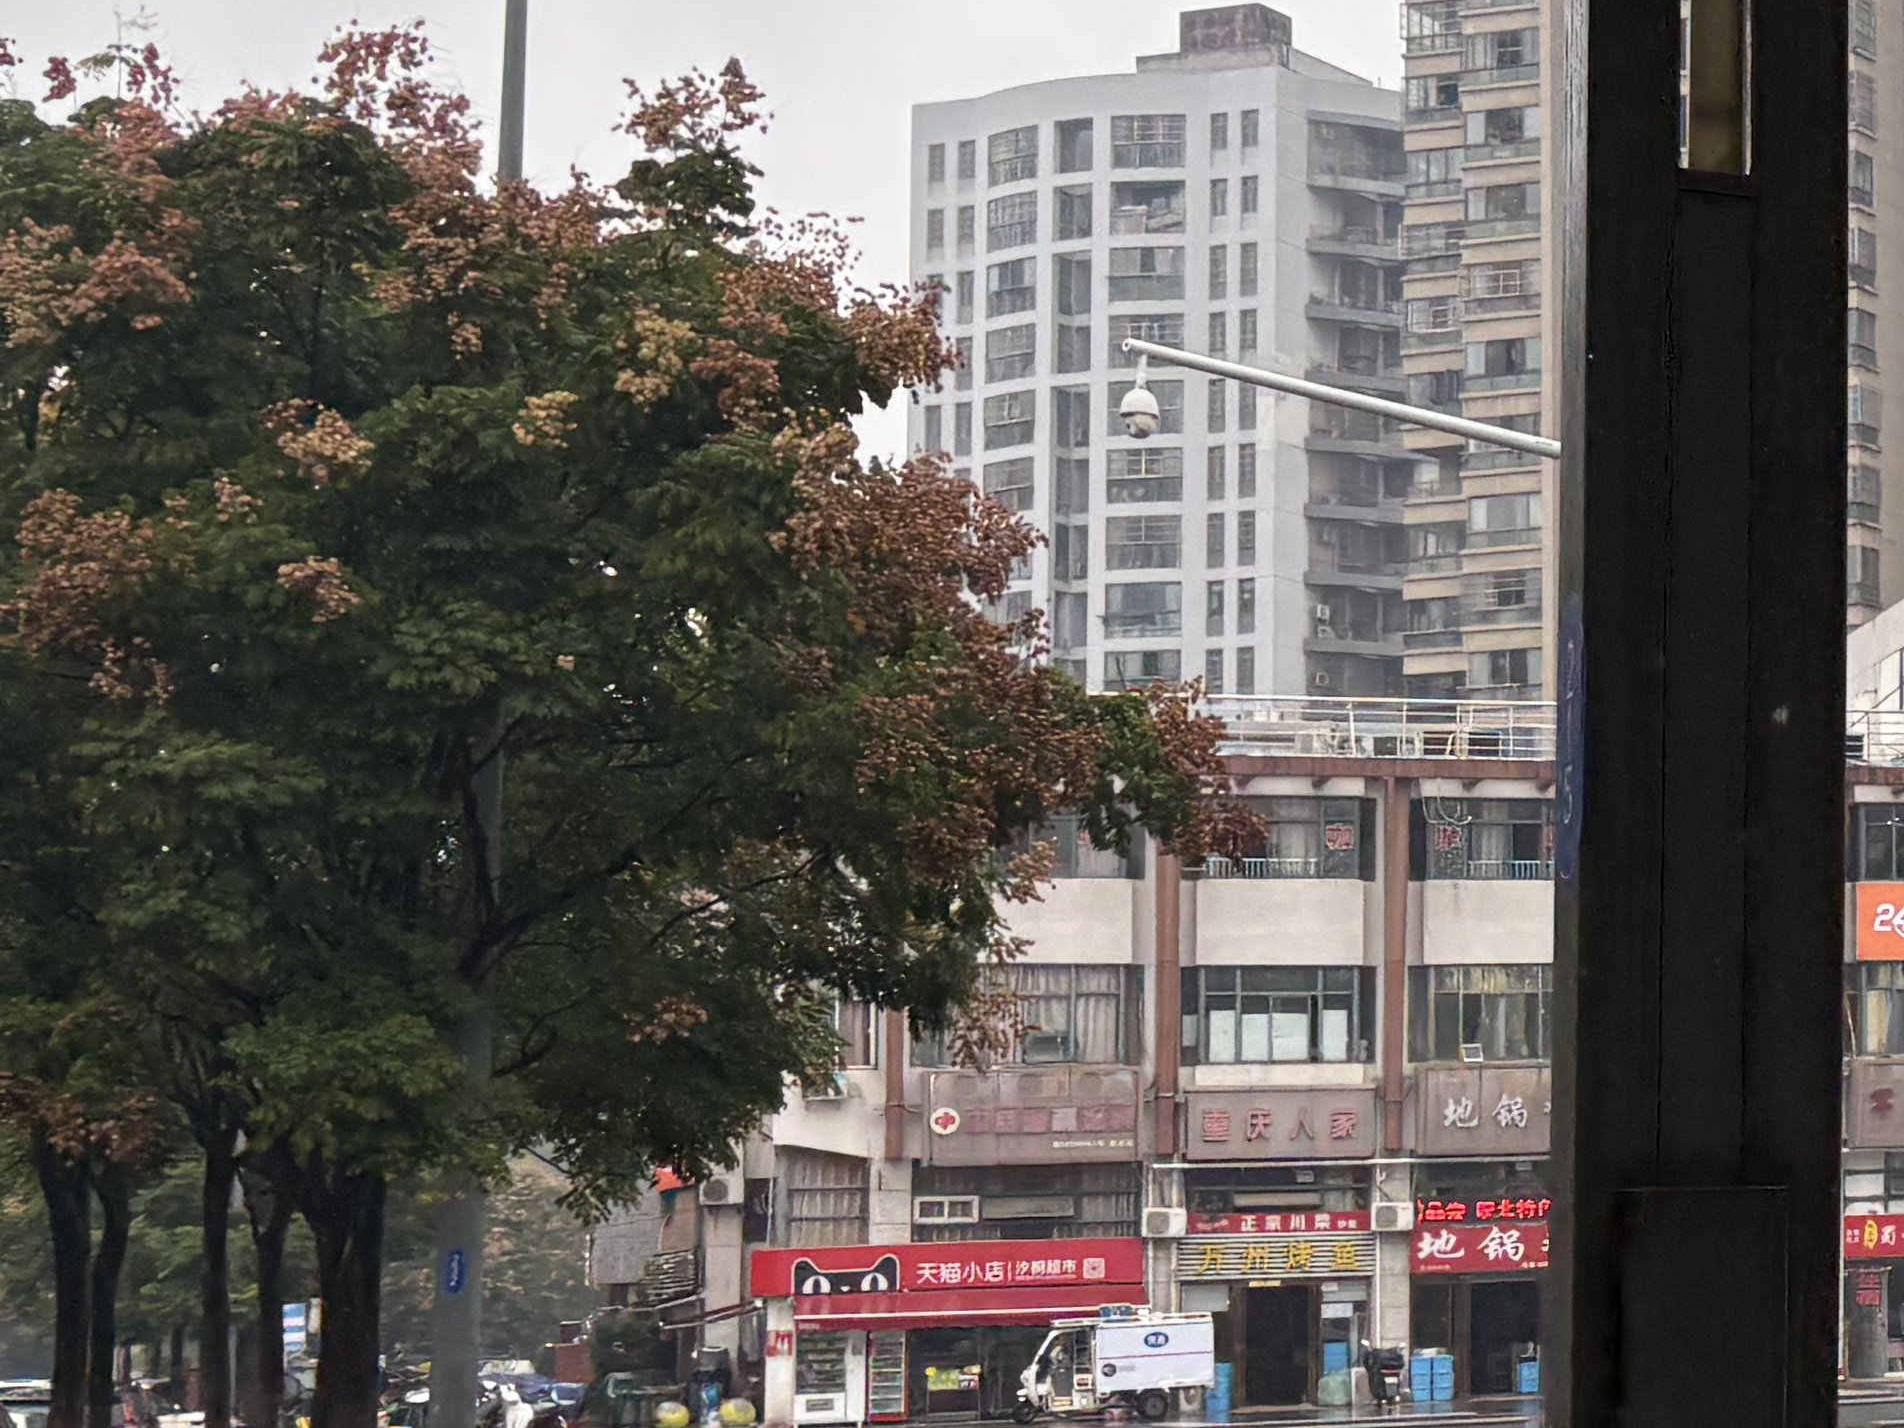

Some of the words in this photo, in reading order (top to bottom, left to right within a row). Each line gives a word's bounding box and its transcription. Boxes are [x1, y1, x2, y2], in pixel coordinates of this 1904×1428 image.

[1202, 1108, 1358, 1143] 重庆人家
[1443, 1093, 1551, 1129] 地锅
[1198, 1239, 1360, 1273] 万州烤鱼
[1417, 1225, 1550, 1262] 地锅
[916, 1261, 1005, 1285] 天猫小店
